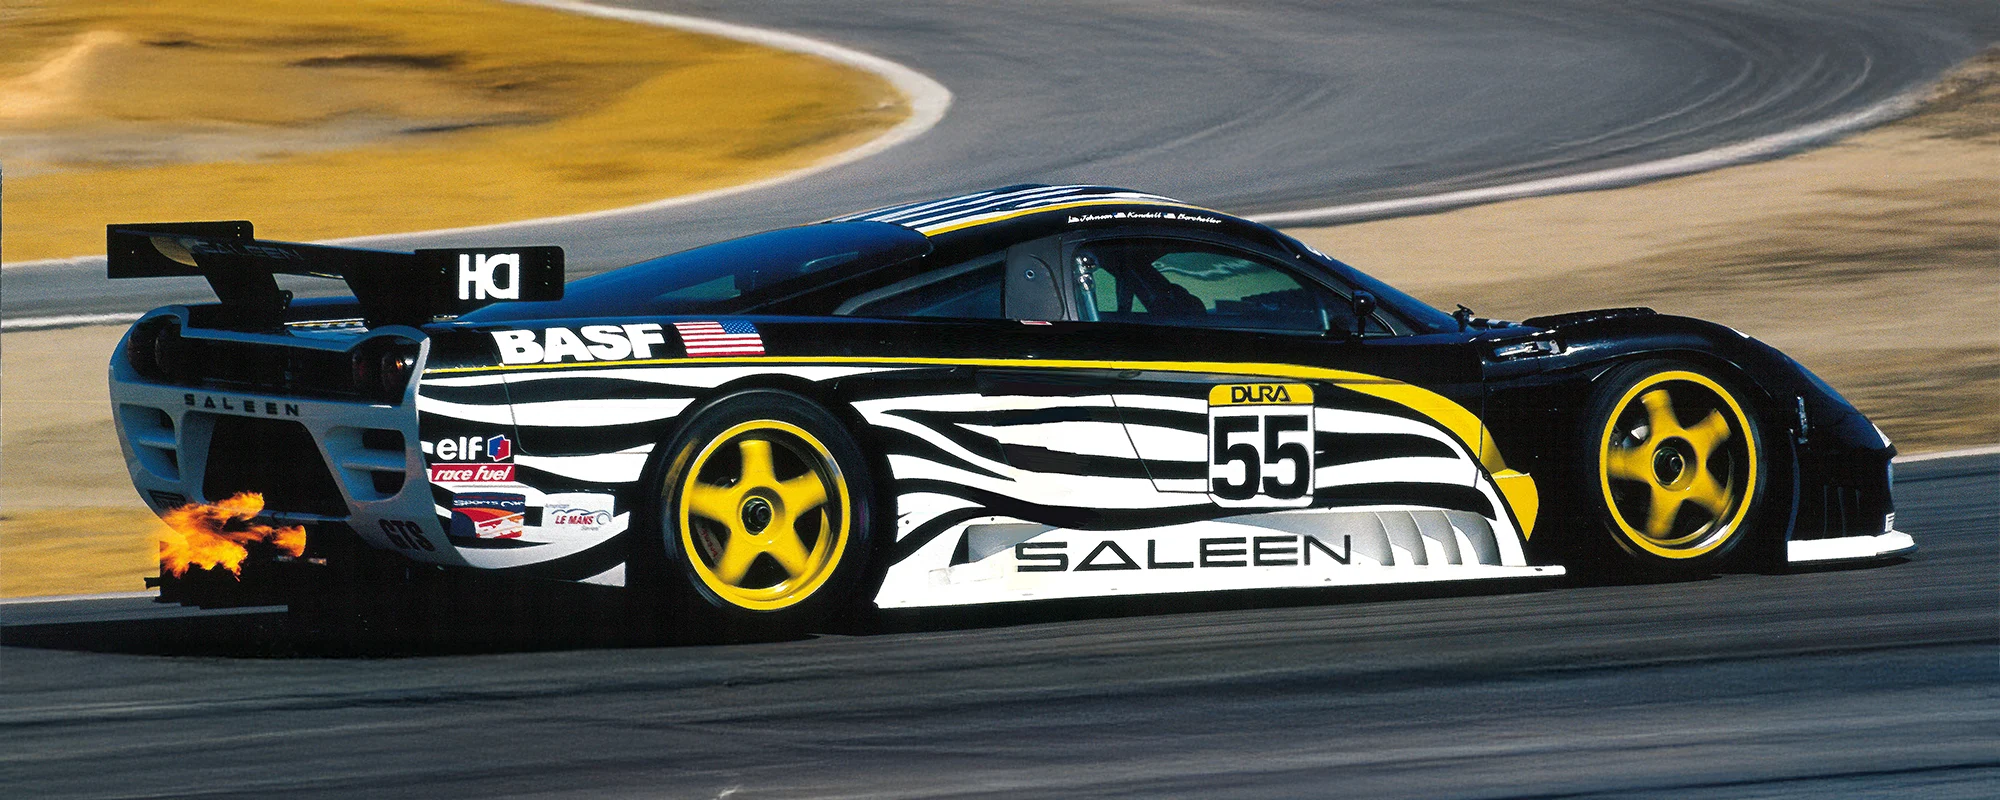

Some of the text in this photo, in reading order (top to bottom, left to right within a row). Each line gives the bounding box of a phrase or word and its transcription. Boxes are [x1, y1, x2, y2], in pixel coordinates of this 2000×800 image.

[491, 323, 665, 364] BASF
[184, 393, 299, 417] SALEEN
[1231, 385, 1291, 403] DURA
[436, 436, 483, 461] elf
[1212, 414, 1310, 500] 55
[434, 466, 512, 481] race fuel
[555, 515, 594, 525] LE MANS
[1015, 534, 1351, 572] SALEEN
